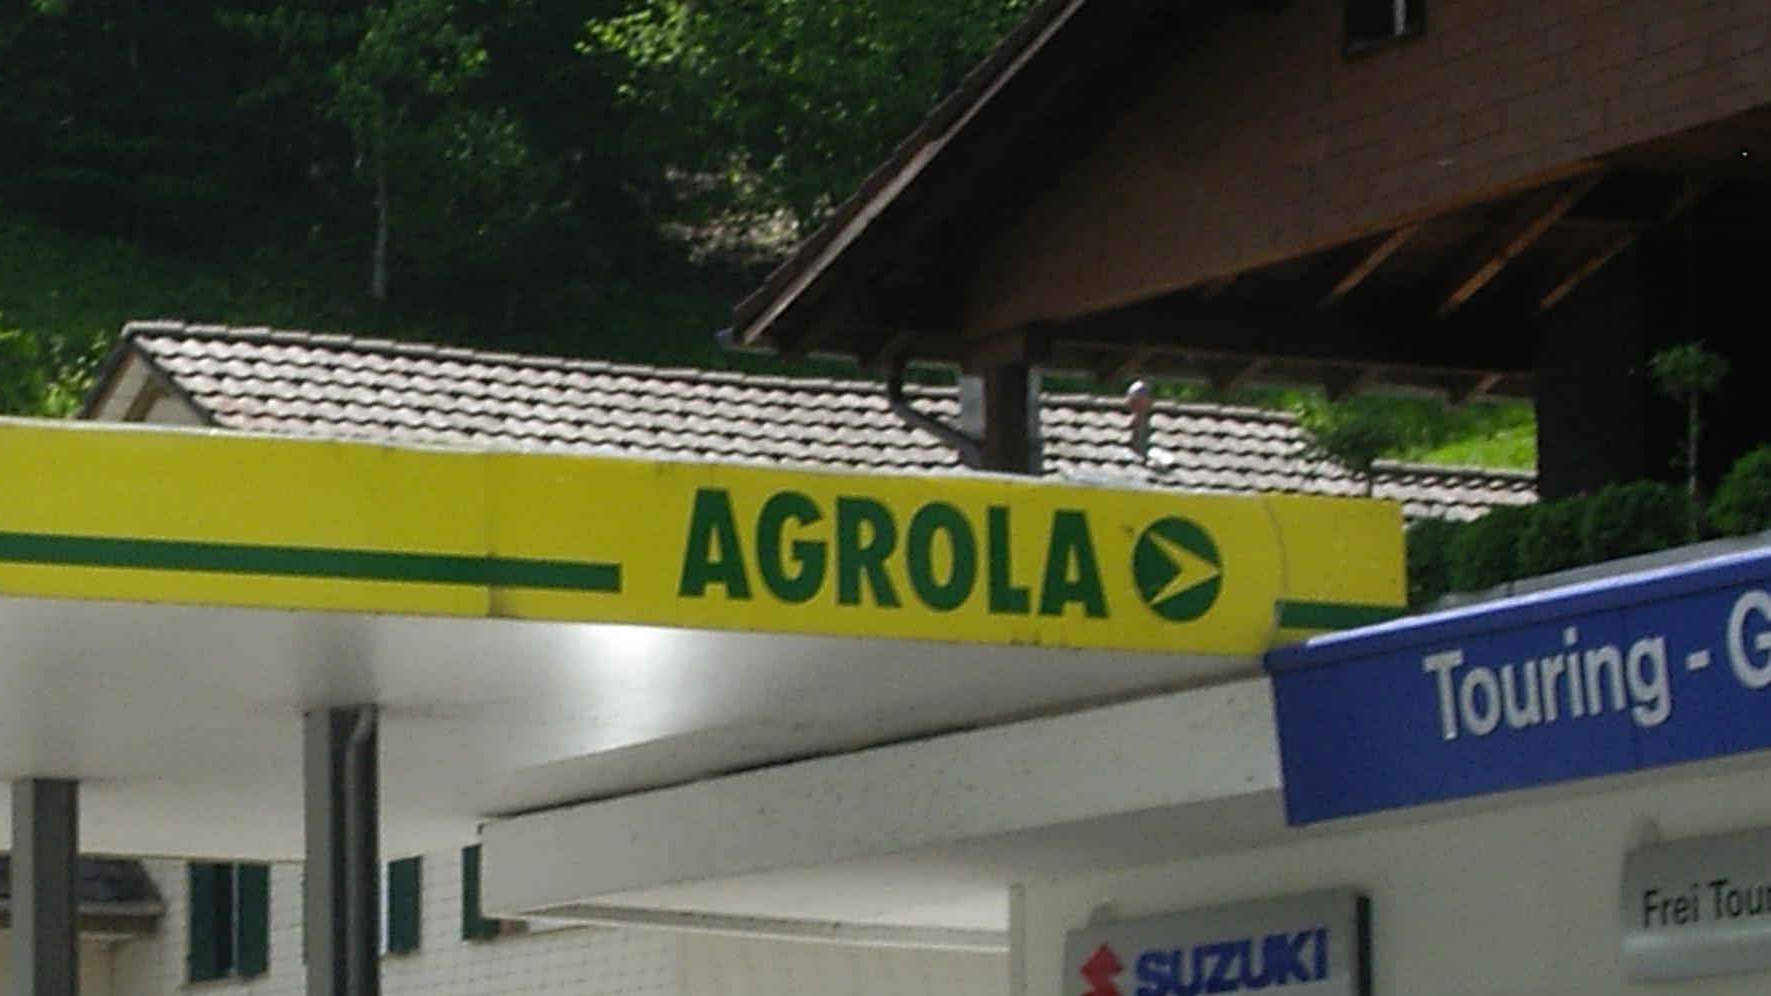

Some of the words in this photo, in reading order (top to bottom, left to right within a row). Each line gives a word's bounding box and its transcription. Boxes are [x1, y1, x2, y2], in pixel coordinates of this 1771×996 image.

[678, 487, 1109, 619] AGROLA
[1423, 627, 1671, 741] Touring
[1685, 648, 1711, 671] -
[1643, 882, 1699, 928] Frei
[1707, 879, 1771, 918] Tou
